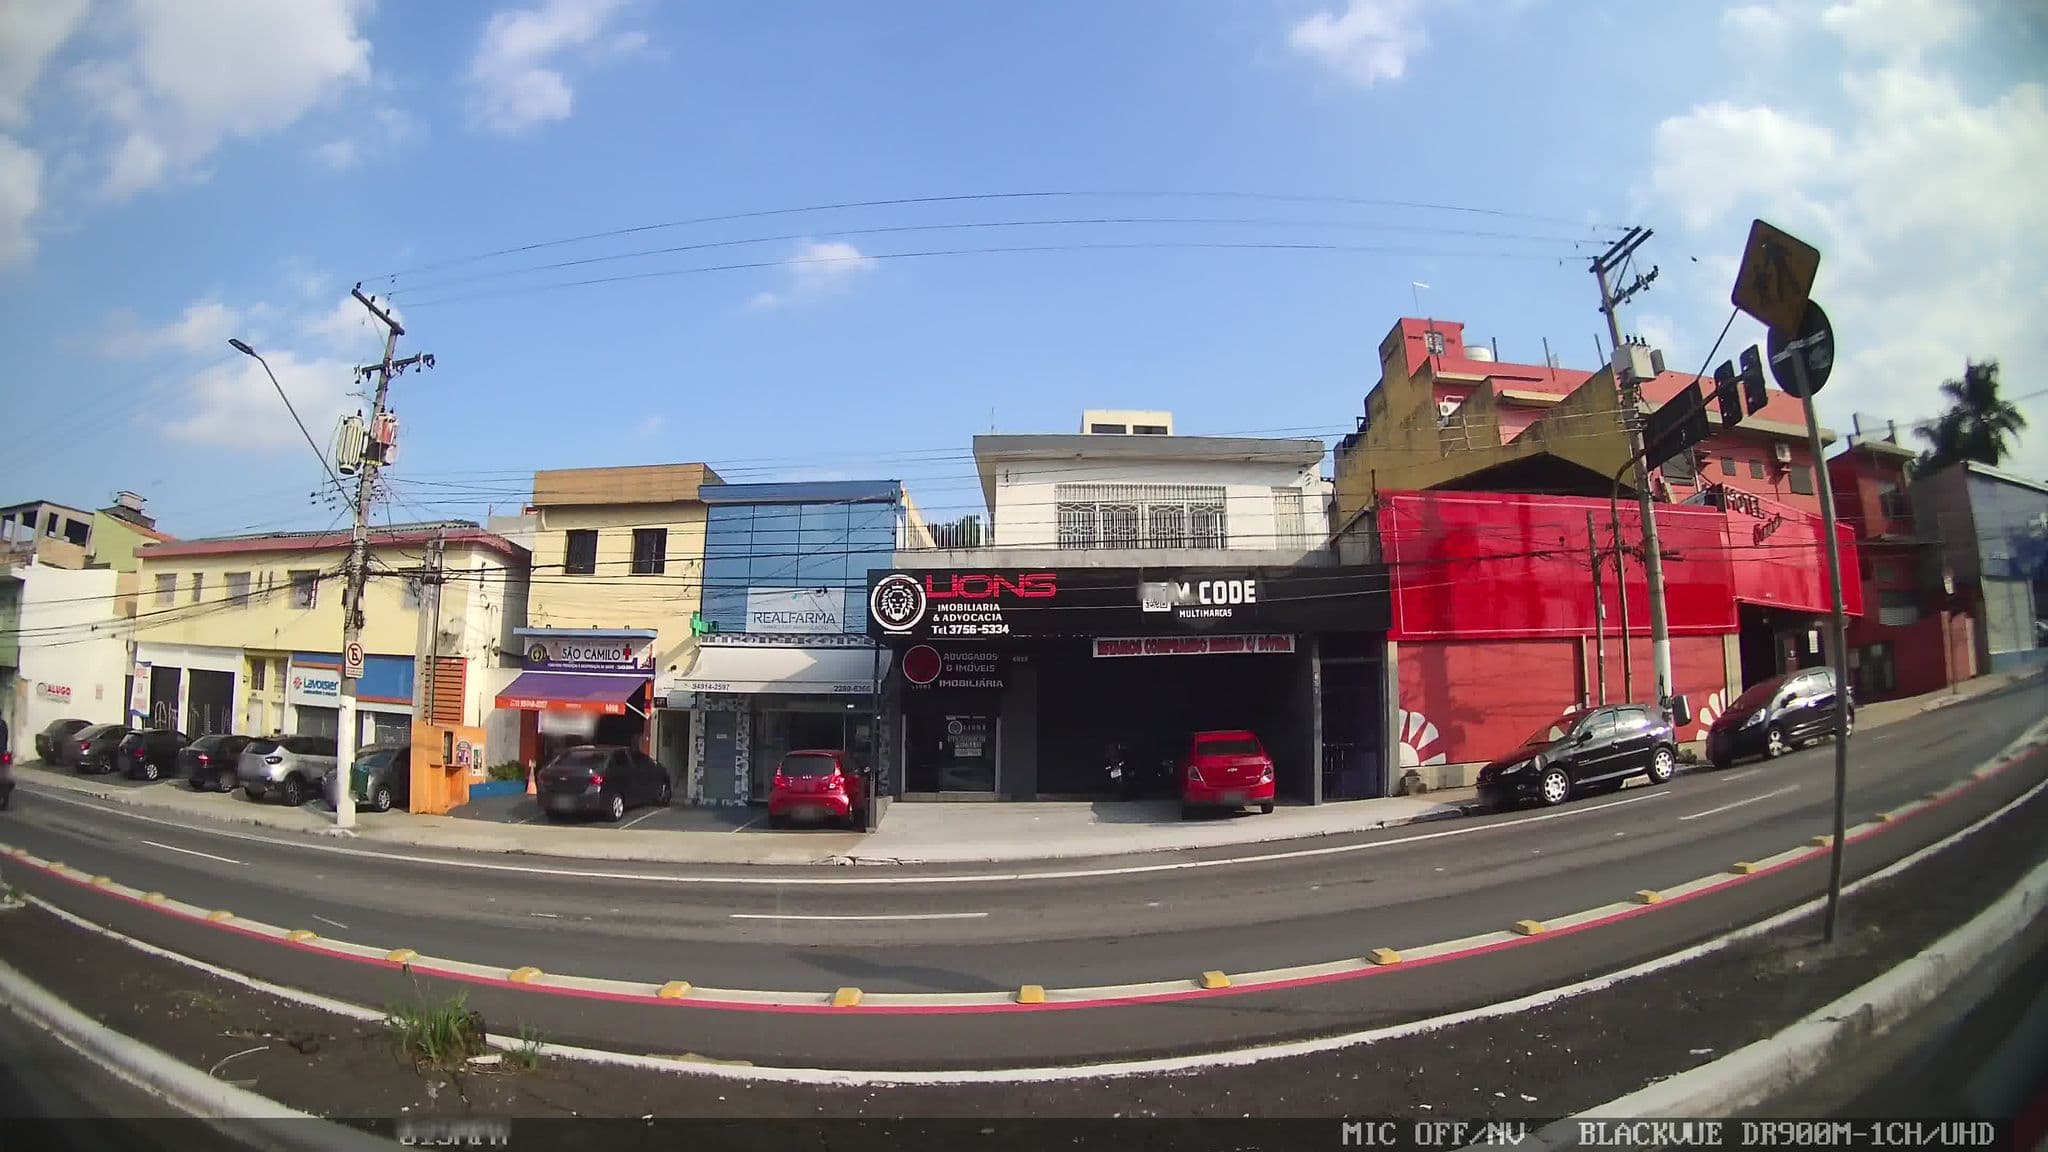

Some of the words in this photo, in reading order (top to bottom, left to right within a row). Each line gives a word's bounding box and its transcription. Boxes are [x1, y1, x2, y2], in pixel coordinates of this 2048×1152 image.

[925, 573, 1057, 598] LIONS
[1199, 580, 1256, 604] CODE
[937, 603, 1001, 612] IMOBILIARIA
[753, 612, 836, 624] REALFARMA
[933, 614, 940, 622] &
[943, 614, 1003, 622] ADVOCACIA
[1180, 608, 1232, 618] MULTIMARCAS
[949, 624, 1010, 635] 3756-5334
[562, 646, 580, 660] SÃO
[583, 647, 620, 661] CAMILO
[943, 653, 999, 661] ADVOGADOS
[956, 663, 996, 672] IMÓVEIS
[939, 678, 1004, 688] IMOBILIÁRIA
